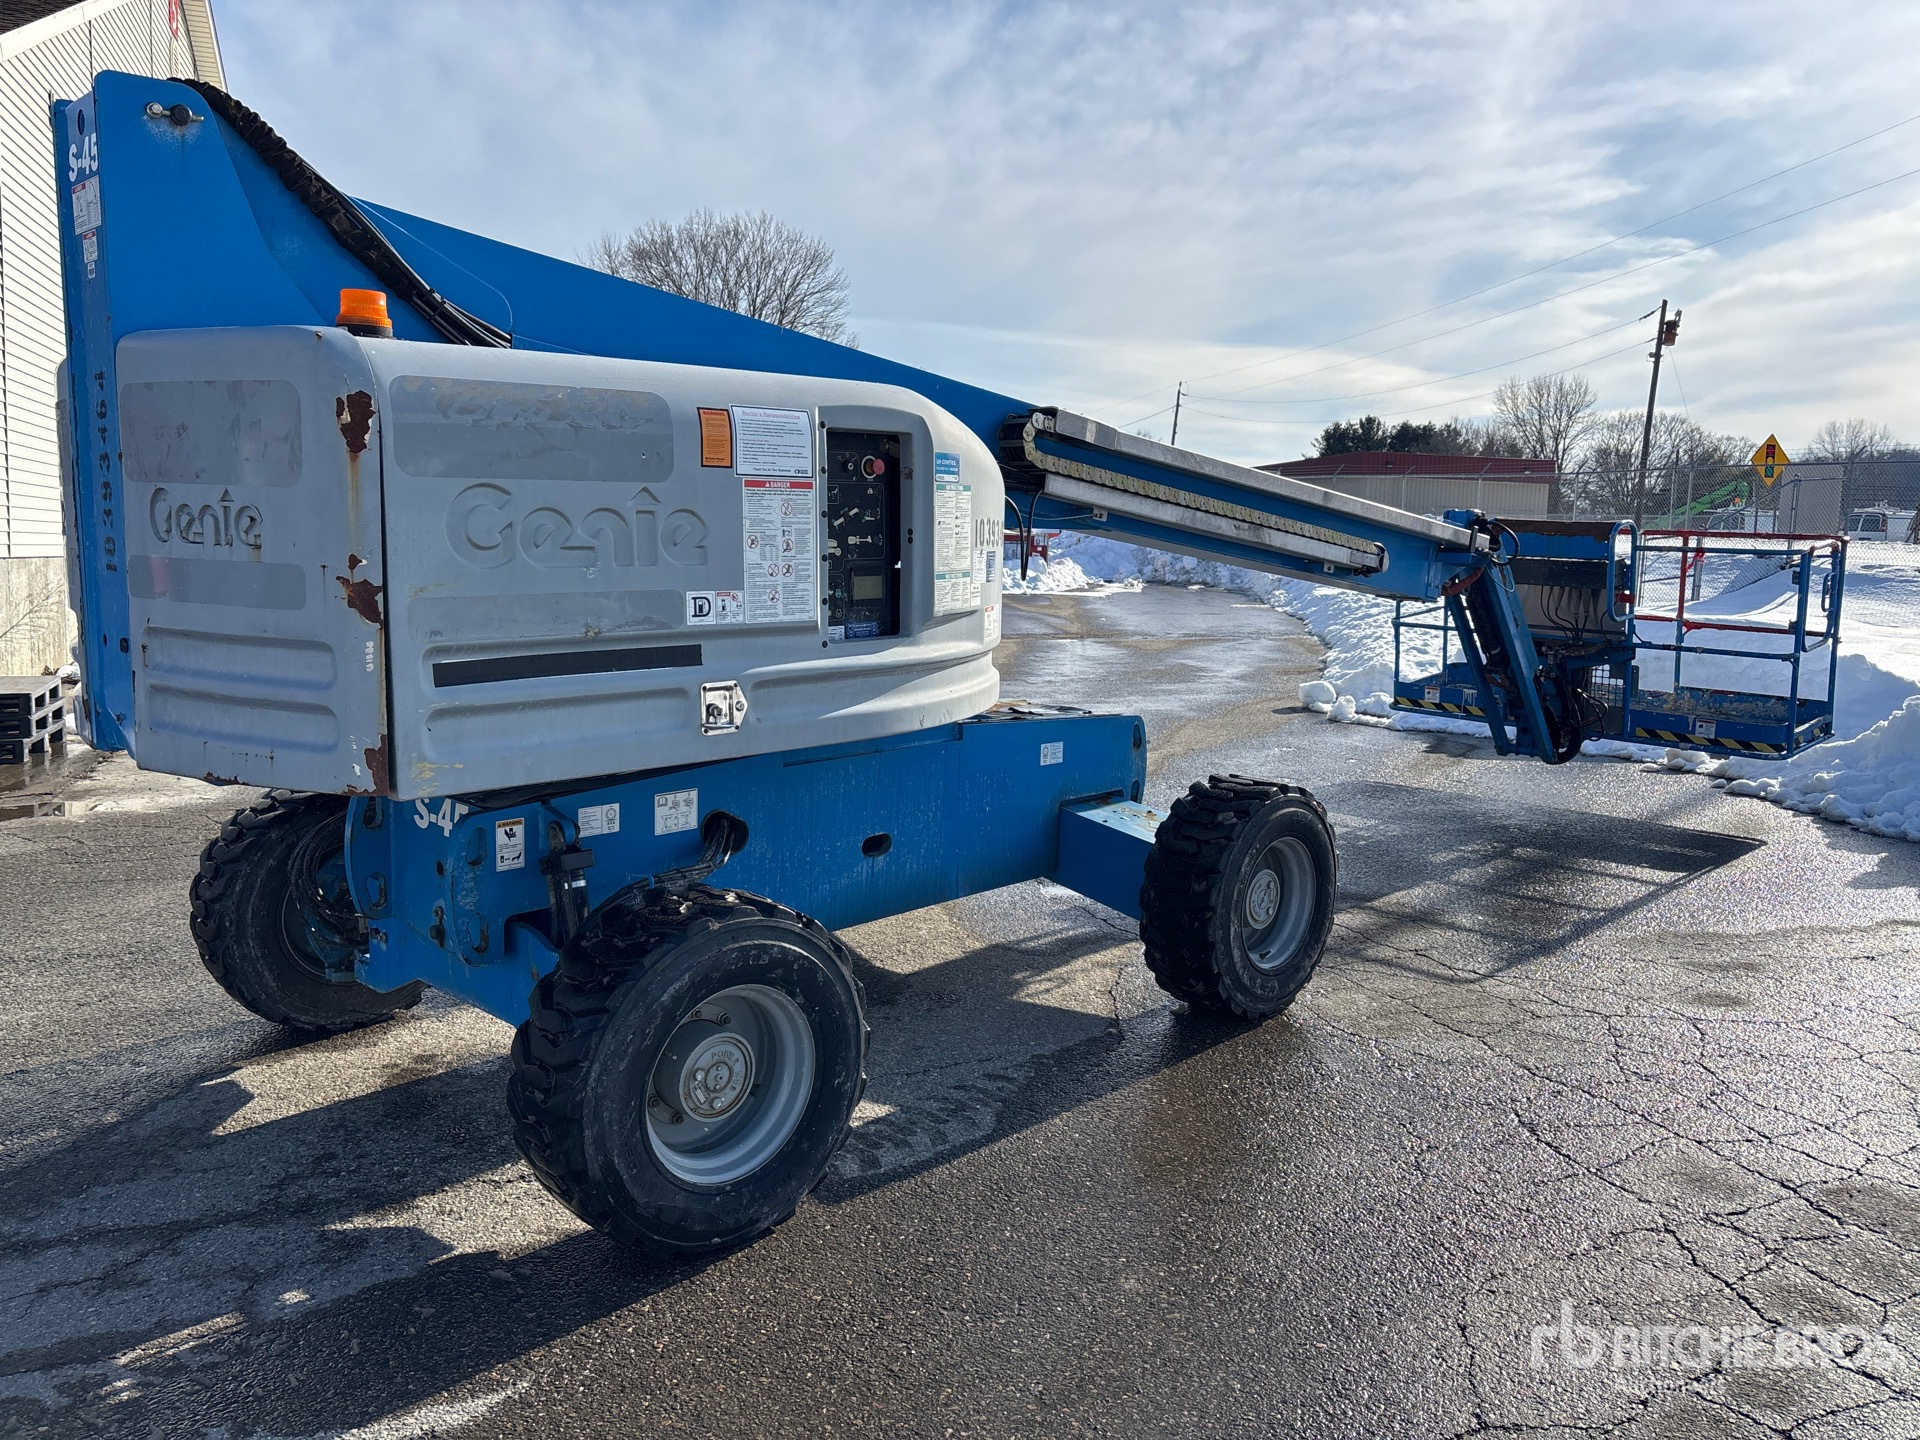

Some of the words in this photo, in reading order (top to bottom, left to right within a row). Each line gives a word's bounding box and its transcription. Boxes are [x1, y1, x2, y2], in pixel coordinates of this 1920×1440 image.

[68, 132, 98, 182] S-45
[149, 487, 264, 548] Genie
[445, 483, 708, 569] Genie
